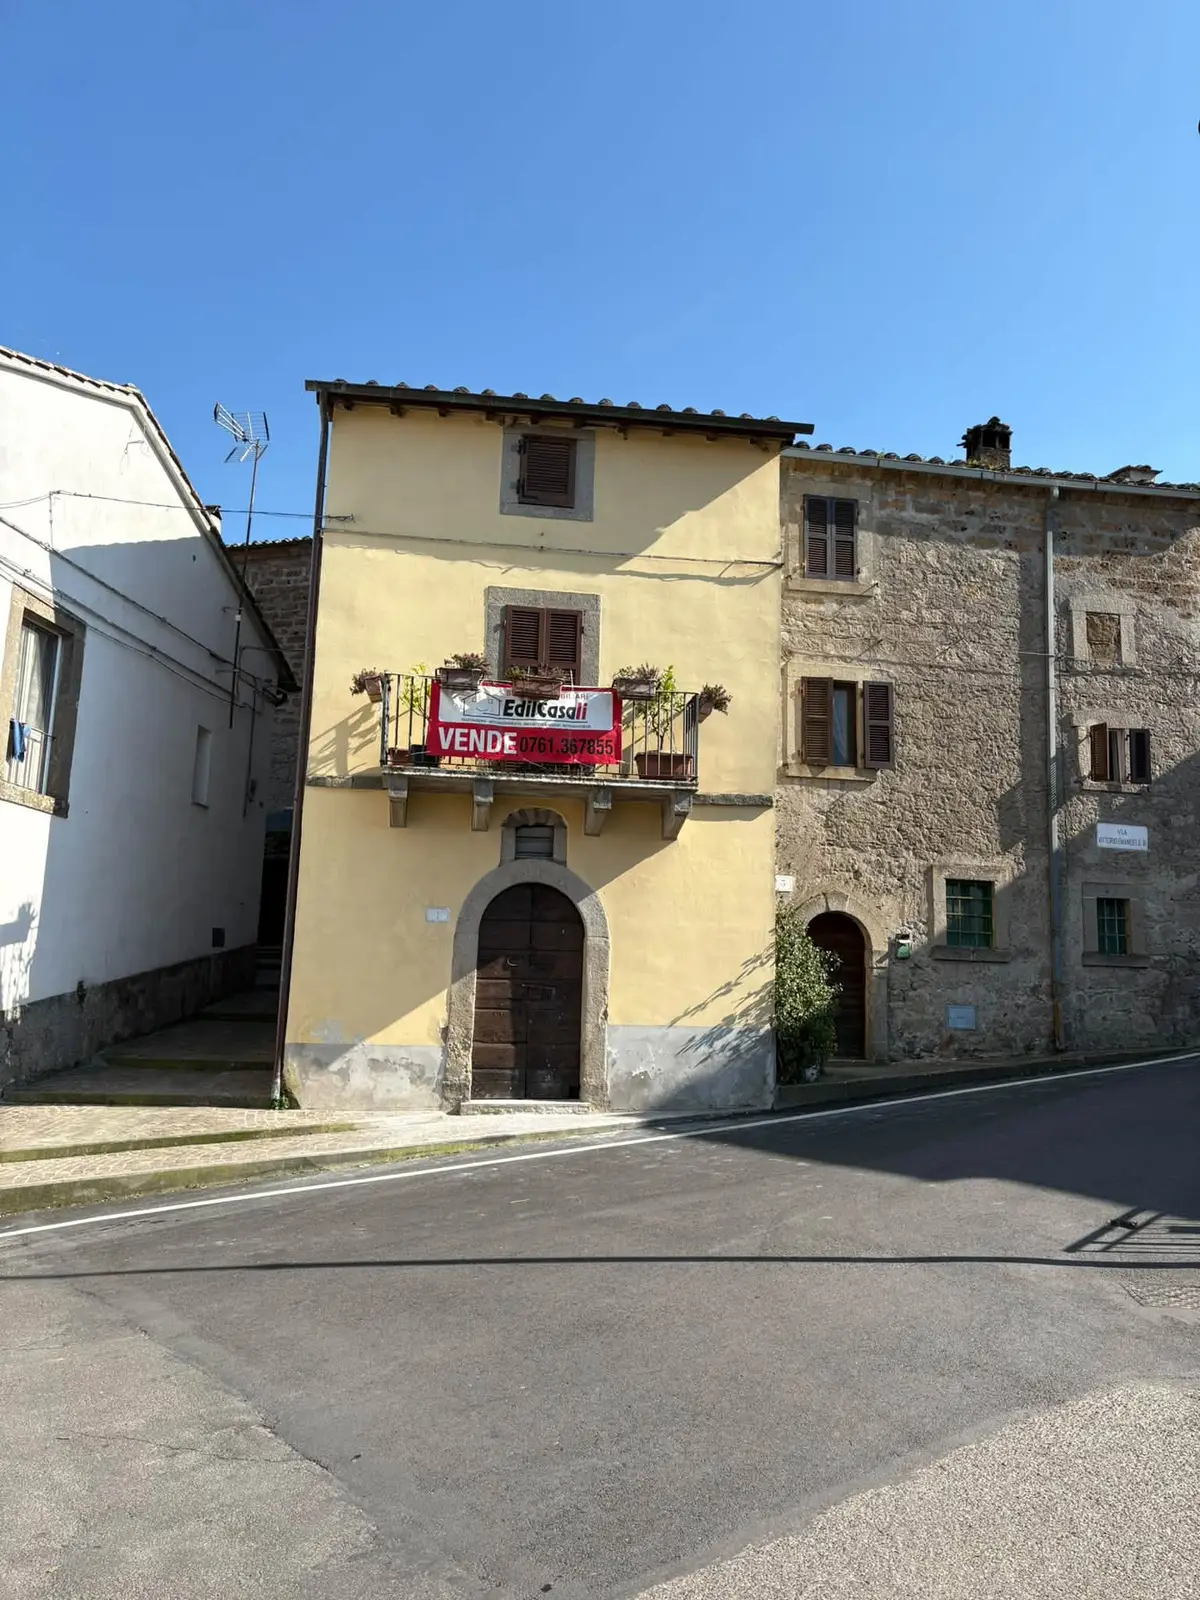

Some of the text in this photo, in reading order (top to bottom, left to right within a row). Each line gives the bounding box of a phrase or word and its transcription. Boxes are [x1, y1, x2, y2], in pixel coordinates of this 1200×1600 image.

[503, 700, 588, 720] EdilCasali
[438, 727, 613, 755] VENDE 0761.367855
[1117, 828, 1127, 836] VIA
